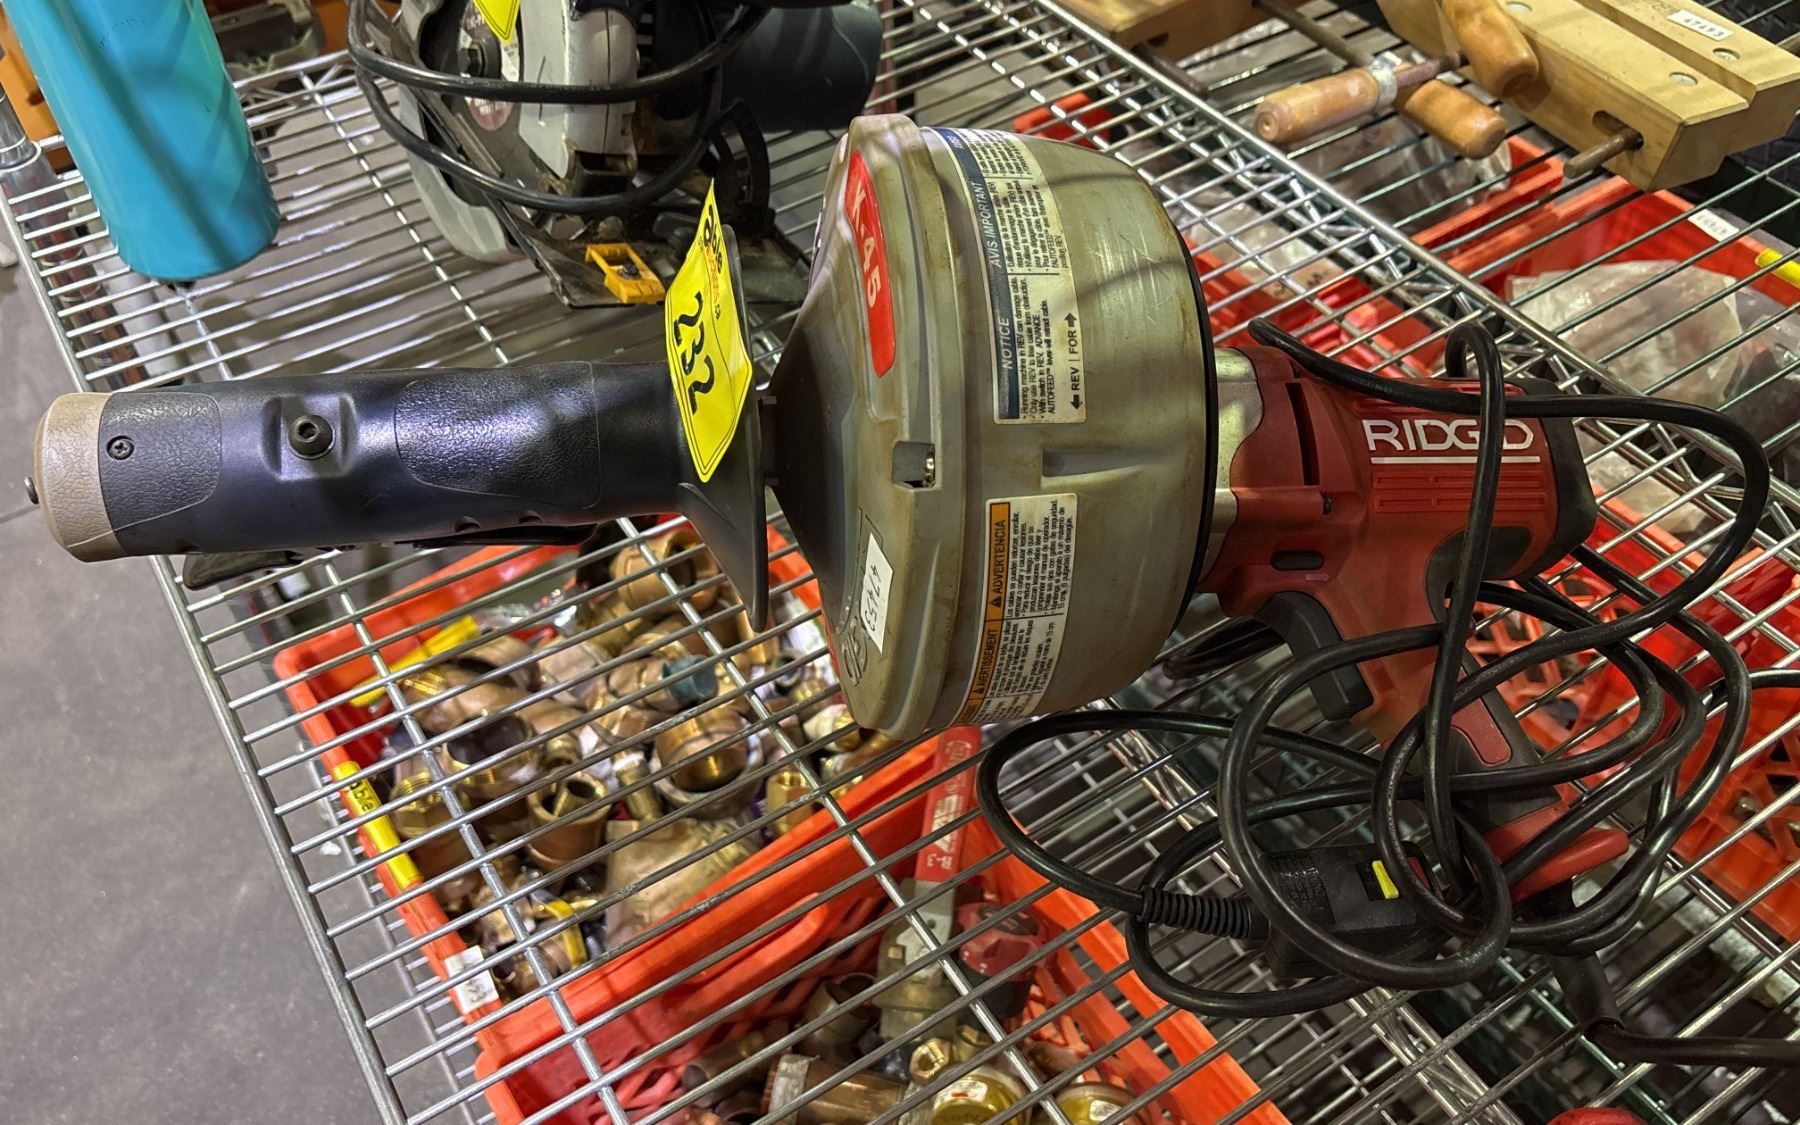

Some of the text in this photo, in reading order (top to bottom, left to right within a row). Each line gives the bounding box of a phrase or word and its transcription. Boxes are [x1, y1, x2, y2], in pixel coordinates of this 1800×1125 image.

[971, 181, 1001, 267] AVIS IMPORTANT
[853, 179, 882, 308] K-45
[1013, 294, 1023, 318] damage
[997, 315, 1012, 369] NOTICE
[1016, 333, 1025, 348] REV
[1032, 314, 1043, 348] ADVANCE
[674, 291, 715, 415] 232
[1066, 329, 1081, 390] REV FOR
[1019, 357, 1027, 384] machine
[1028, 367, 1036, 382] REV
[1021, 386, 1029, 413] Running
[1028, 398, 1039, 413] Only
[1037, 398, 1046, 413] With
[1362, 419, 1534, 451] RIDGD
[991, 519, 1005, 593] ADVERTENCIA
[864, 564, 881, 632] 47453
[977, 628, 997, 686] AVERTISSEMENT
